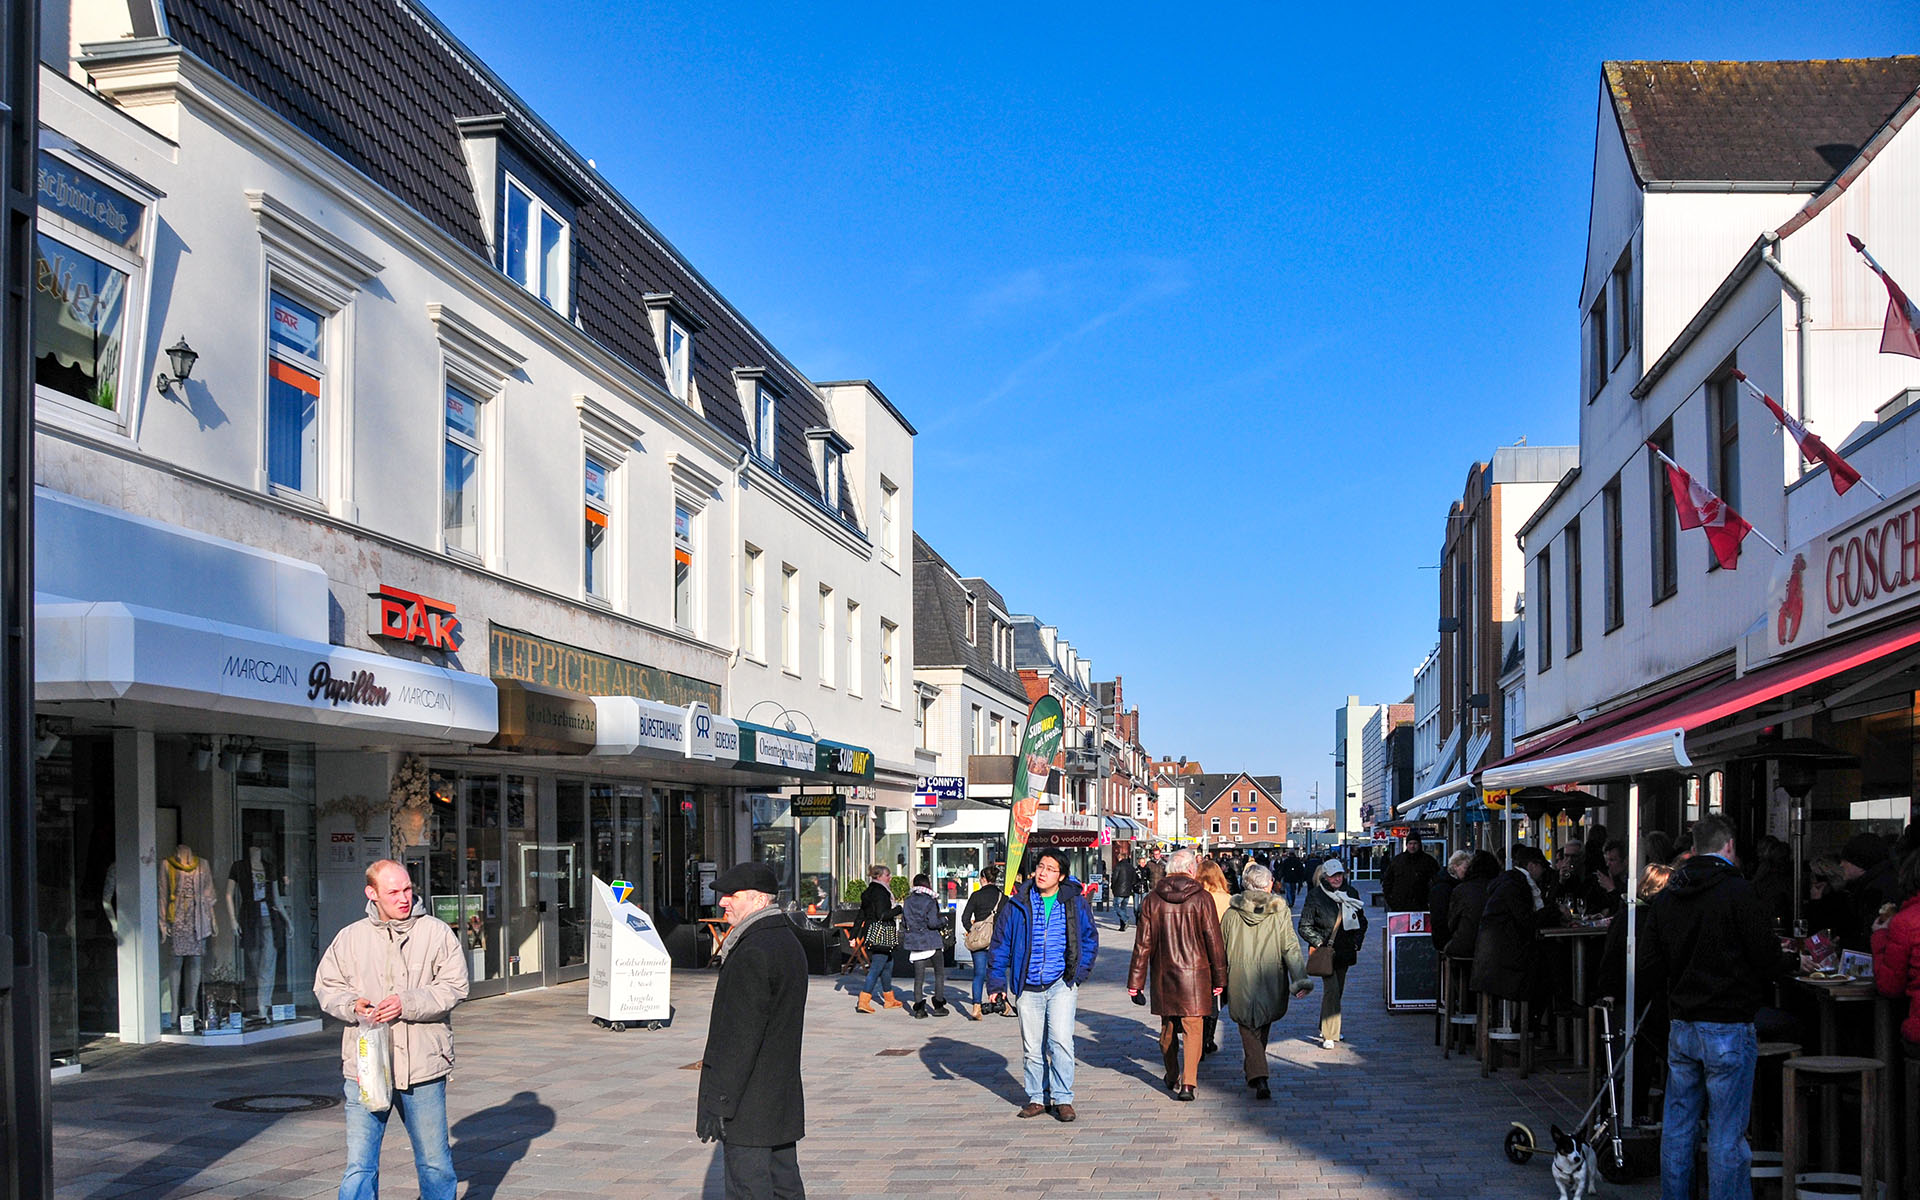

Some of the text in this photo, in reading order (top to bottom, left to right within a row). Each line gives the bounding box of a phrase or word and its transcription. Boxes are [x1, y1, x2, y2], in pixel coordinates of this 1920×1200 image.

[274, 306, 299, 331] DAK
[1825, 504, 1920, 614] GOSCH
[378, 583, 460, 653] DAK
[491, 629, 650, 699] TEPPICHHAUS
[222, 655, 299, 687] MARCCAIN
[307, 661, 391, 707] Papillon
[526, 702, 596, 733] Goldschmiede
[640, 713, 684, 742] BÜRSTENHAUS
[1028, 714, 1057, 740] SUBWAY
[714, 731, 738, 751] EDECKER
[1034, 738, 1044, 751] eat
[837, 747, 870, 775] SUBWAY
[927, 777, 963, 787] CONNY'S
[793, 795, 835, 806] SUBWAY
[331, 833, 355, 843] DAK
[1060, 834, 1095, 843] vodafone
[615, 957, 669, 968] Goldschmiede
[627, 967, 654, 977] Atelier
